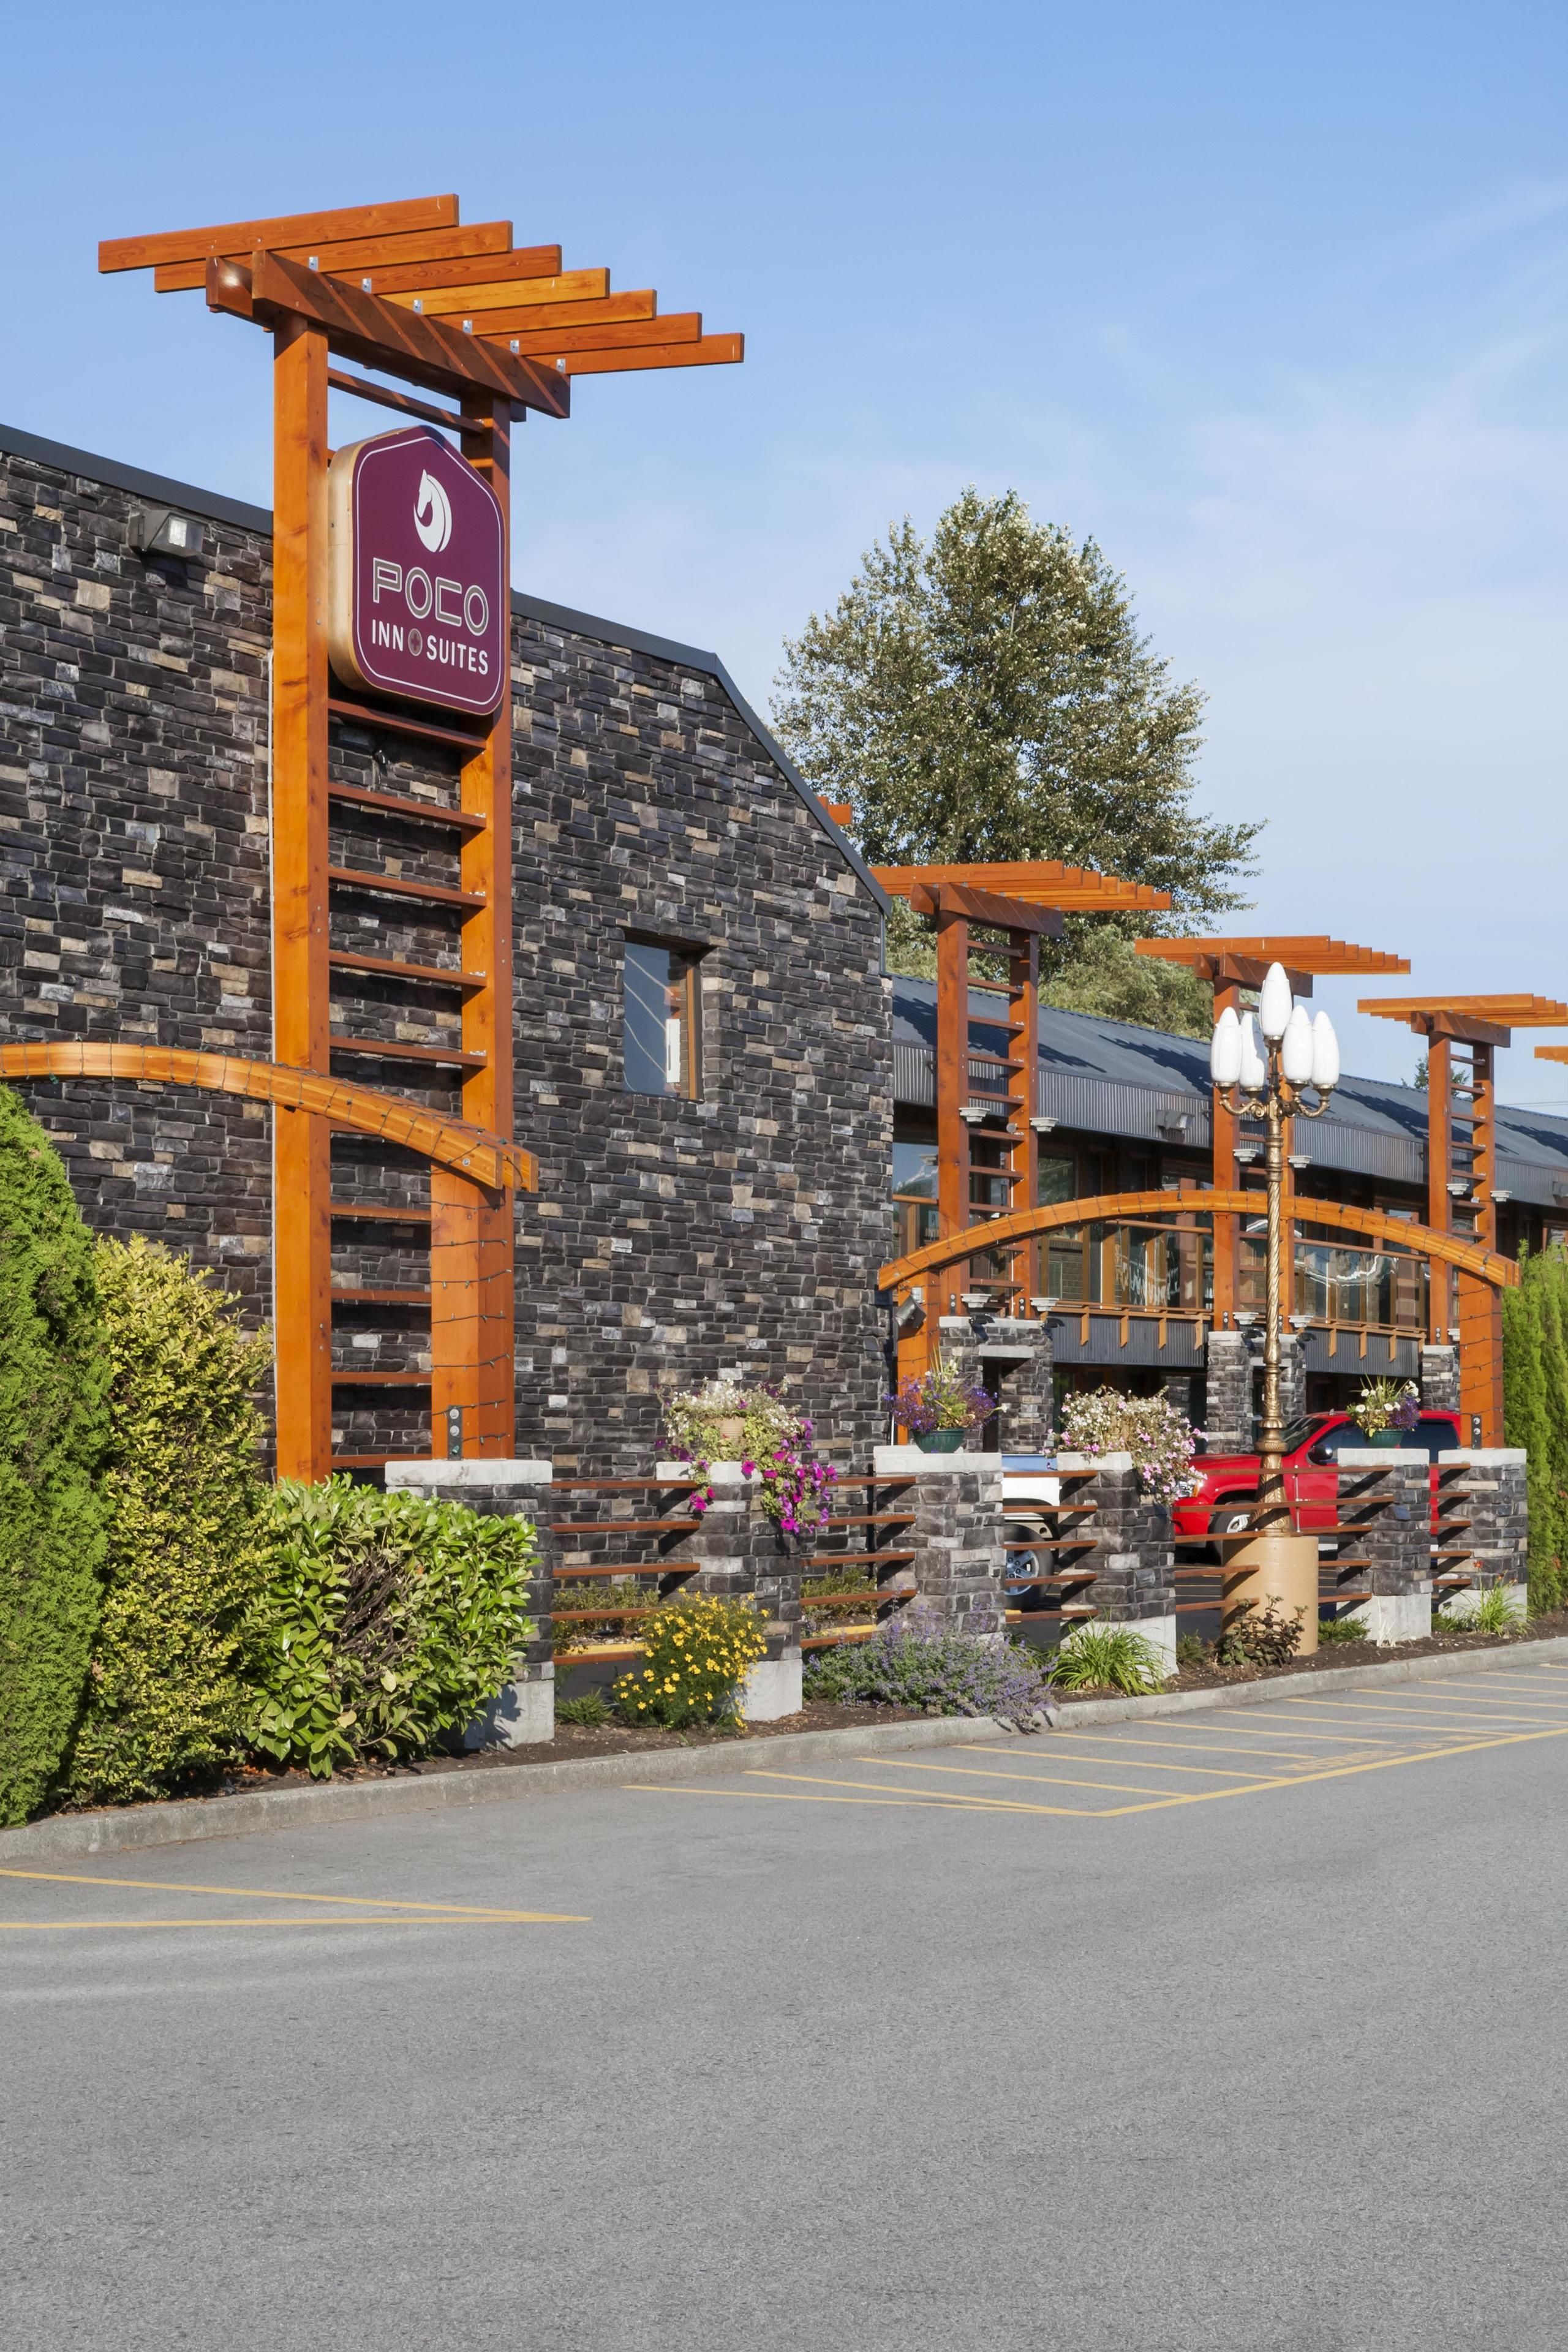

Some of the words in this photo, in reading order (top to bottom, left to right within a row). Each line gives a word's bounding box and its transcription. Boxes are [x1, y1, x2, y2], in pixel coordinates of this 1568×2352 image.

[373, 557, 489, 636] POCO
[372, 619, 404, 652] INN
[426, 635, 488, 675] SUITES
